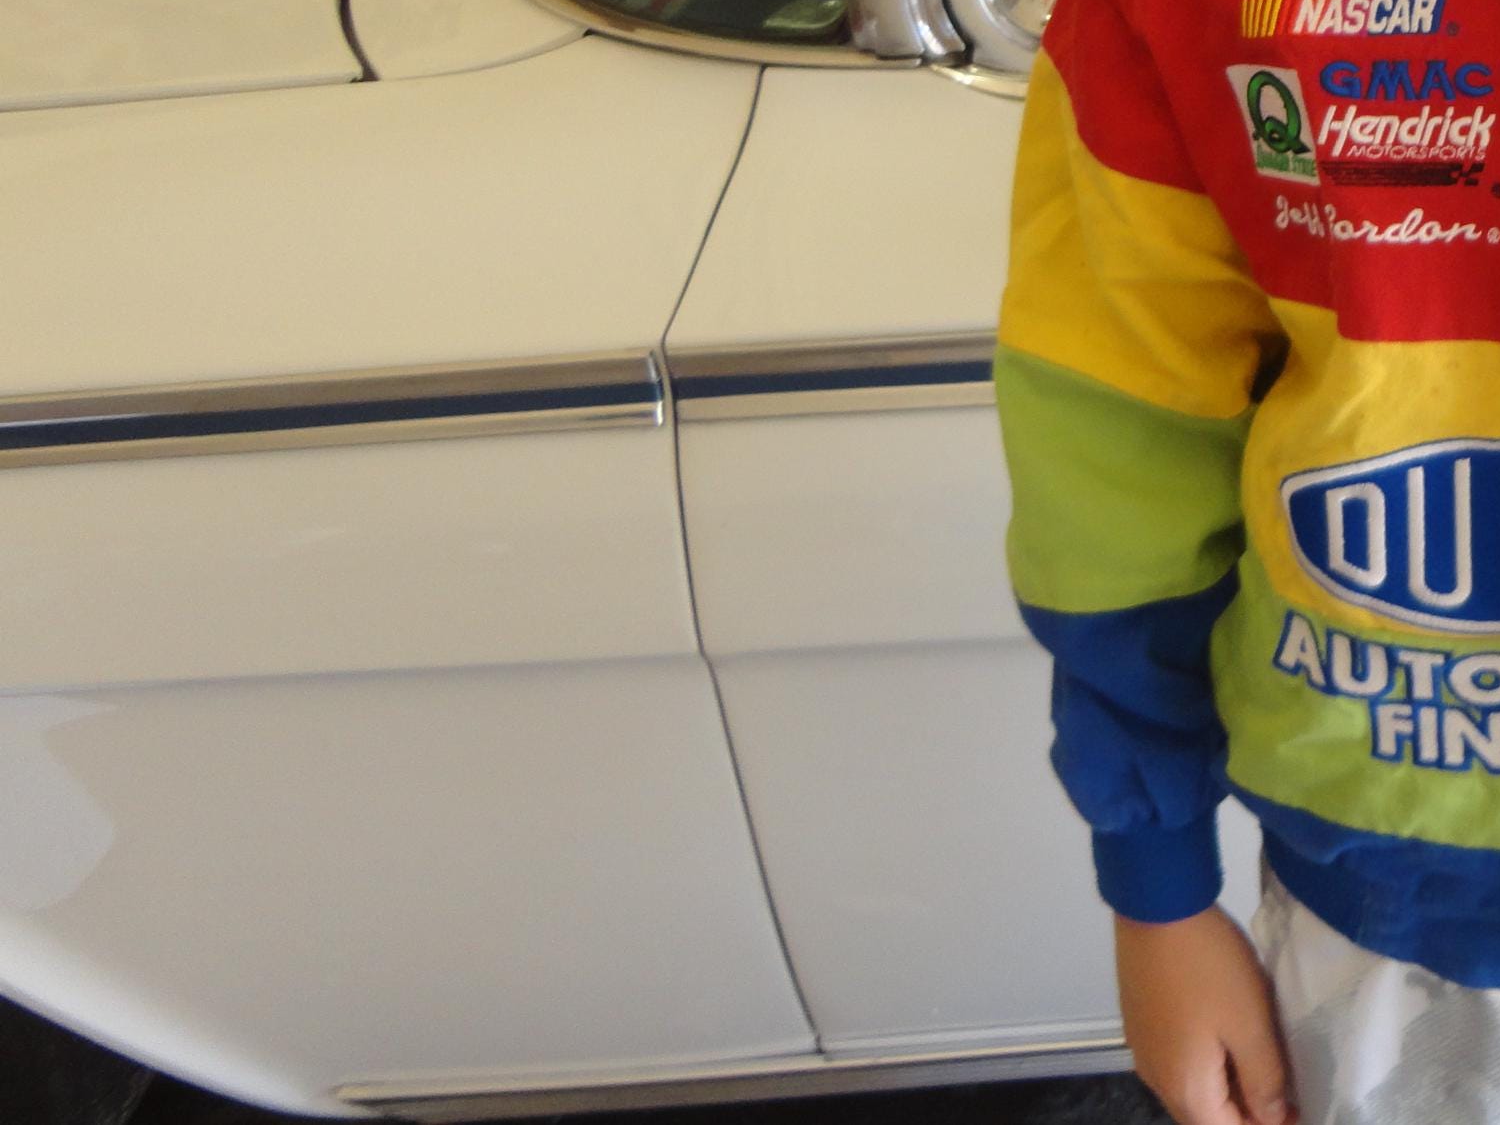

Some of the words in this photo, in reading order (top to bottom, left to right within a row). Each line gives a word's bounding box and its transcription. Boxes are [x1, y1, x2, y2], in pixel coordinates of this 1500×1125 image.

[1319, 60, 1494, 100] GMAC
[1316, 105, 1496, 157] Hendrick
[1346, 145, 1486, 161] MOTORSPORTS
[1325, 457, 1472, 608] DU
